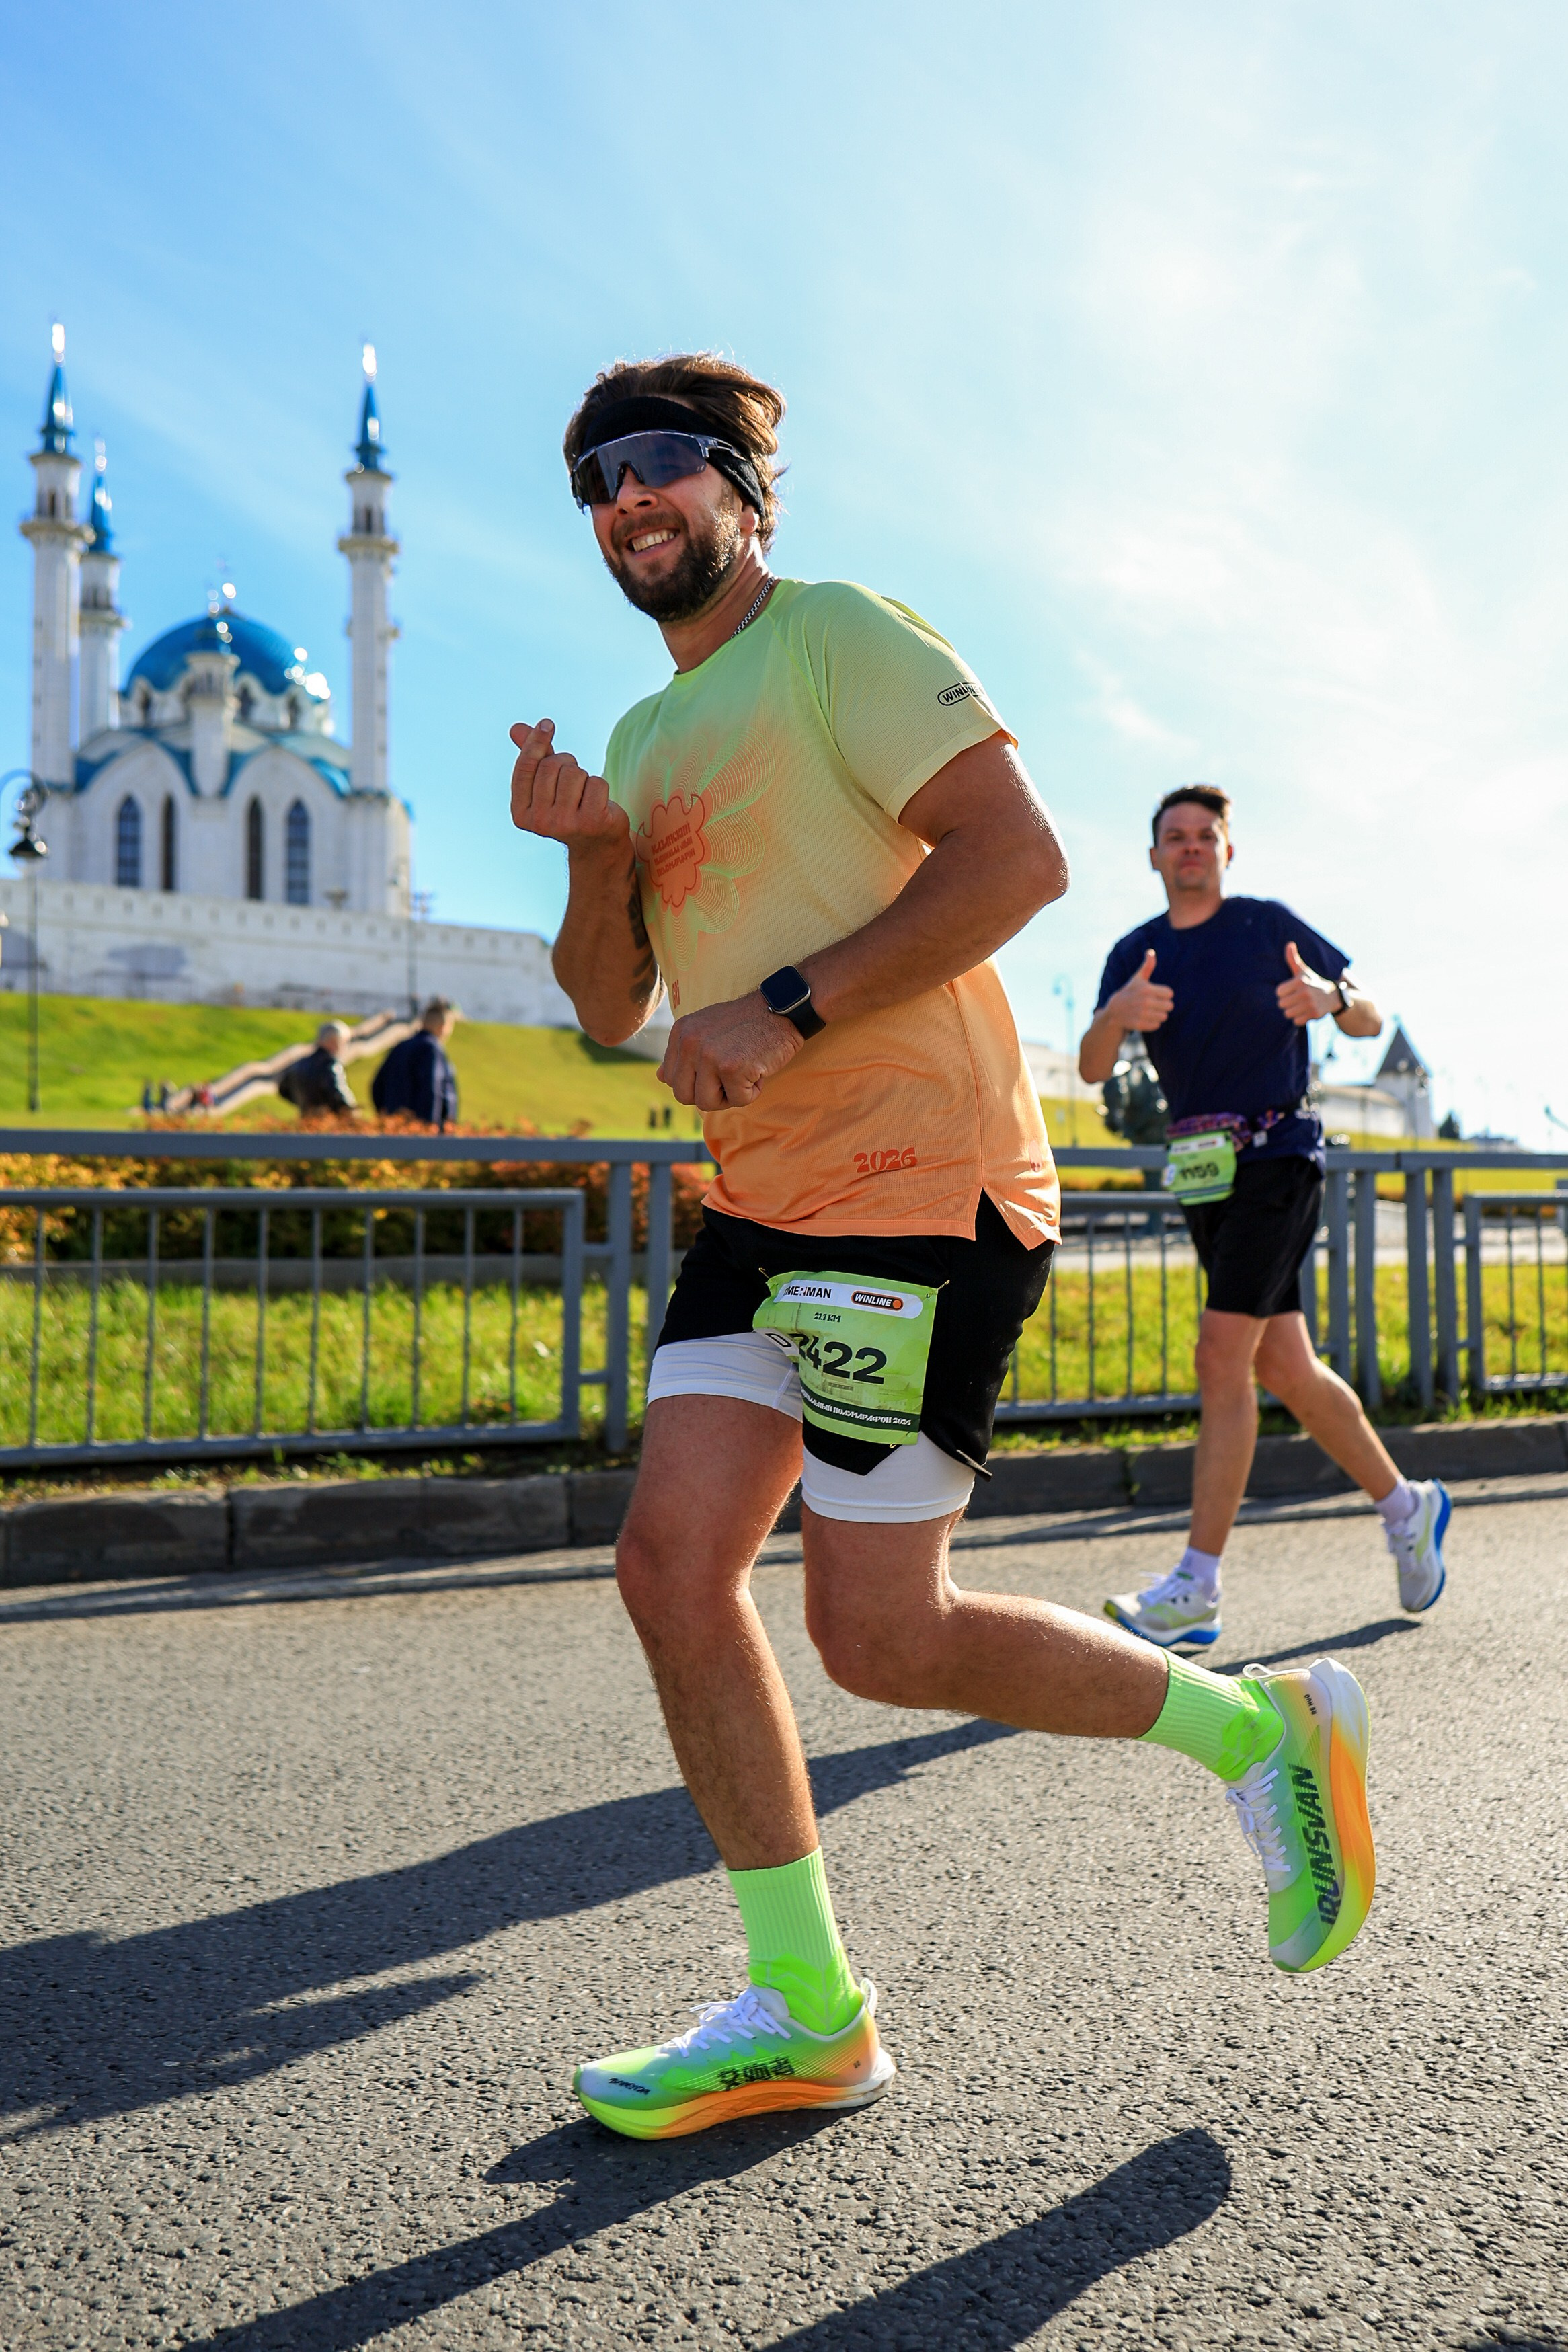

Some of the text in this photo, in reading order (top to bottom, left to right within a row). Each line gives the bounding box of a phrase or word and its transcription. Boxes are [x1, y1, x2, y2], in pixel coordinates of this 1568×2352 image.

[854, 1147, 918, 1172] 2026
[855, 1294, 892, 1307] WINLINE
[833, 1407, 892, 1423] ПОЛУМАРАФОН
